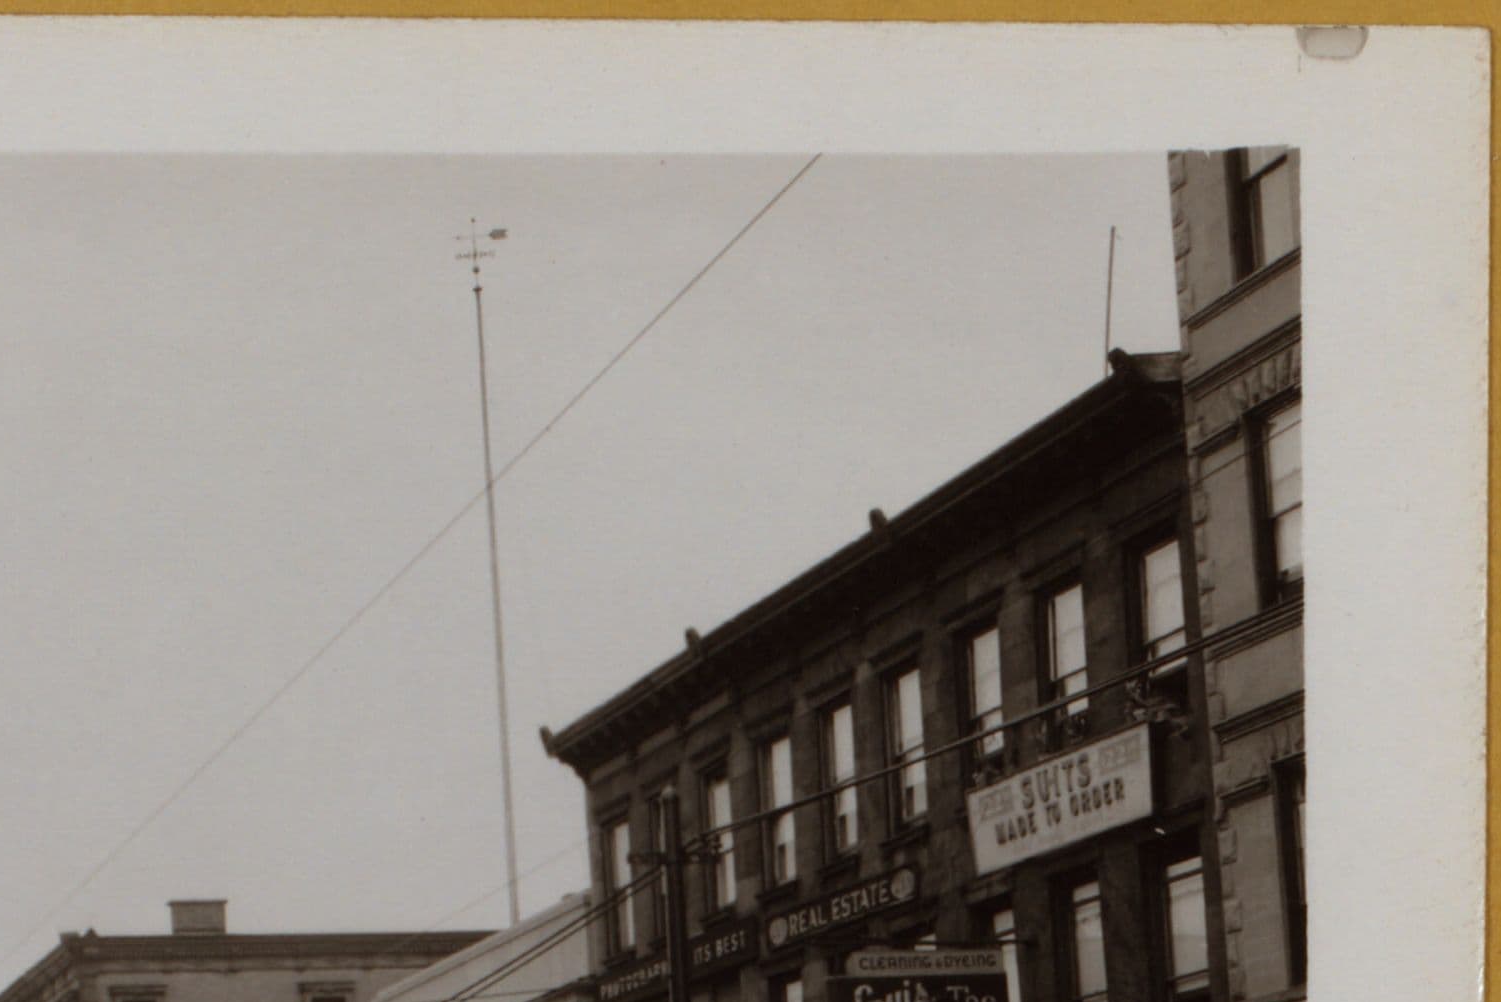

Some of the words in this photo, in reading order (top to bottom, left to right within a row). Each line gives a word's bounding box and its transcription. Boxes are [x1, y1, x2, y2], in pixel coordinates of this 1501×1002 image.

[1021, 753, 1091, 810] SUITS
[994, 811, 1038, 845] MADE
[1045, 801, 1062, 828] TO
[1069, 777, 1125, 817] ORDER
[787, 904, 828, 937] REAL
[830, 880, 891, 922] ESTATE
[714, 930, 747, 960] BEST
[858, 954, 932, 971] CLEANING
